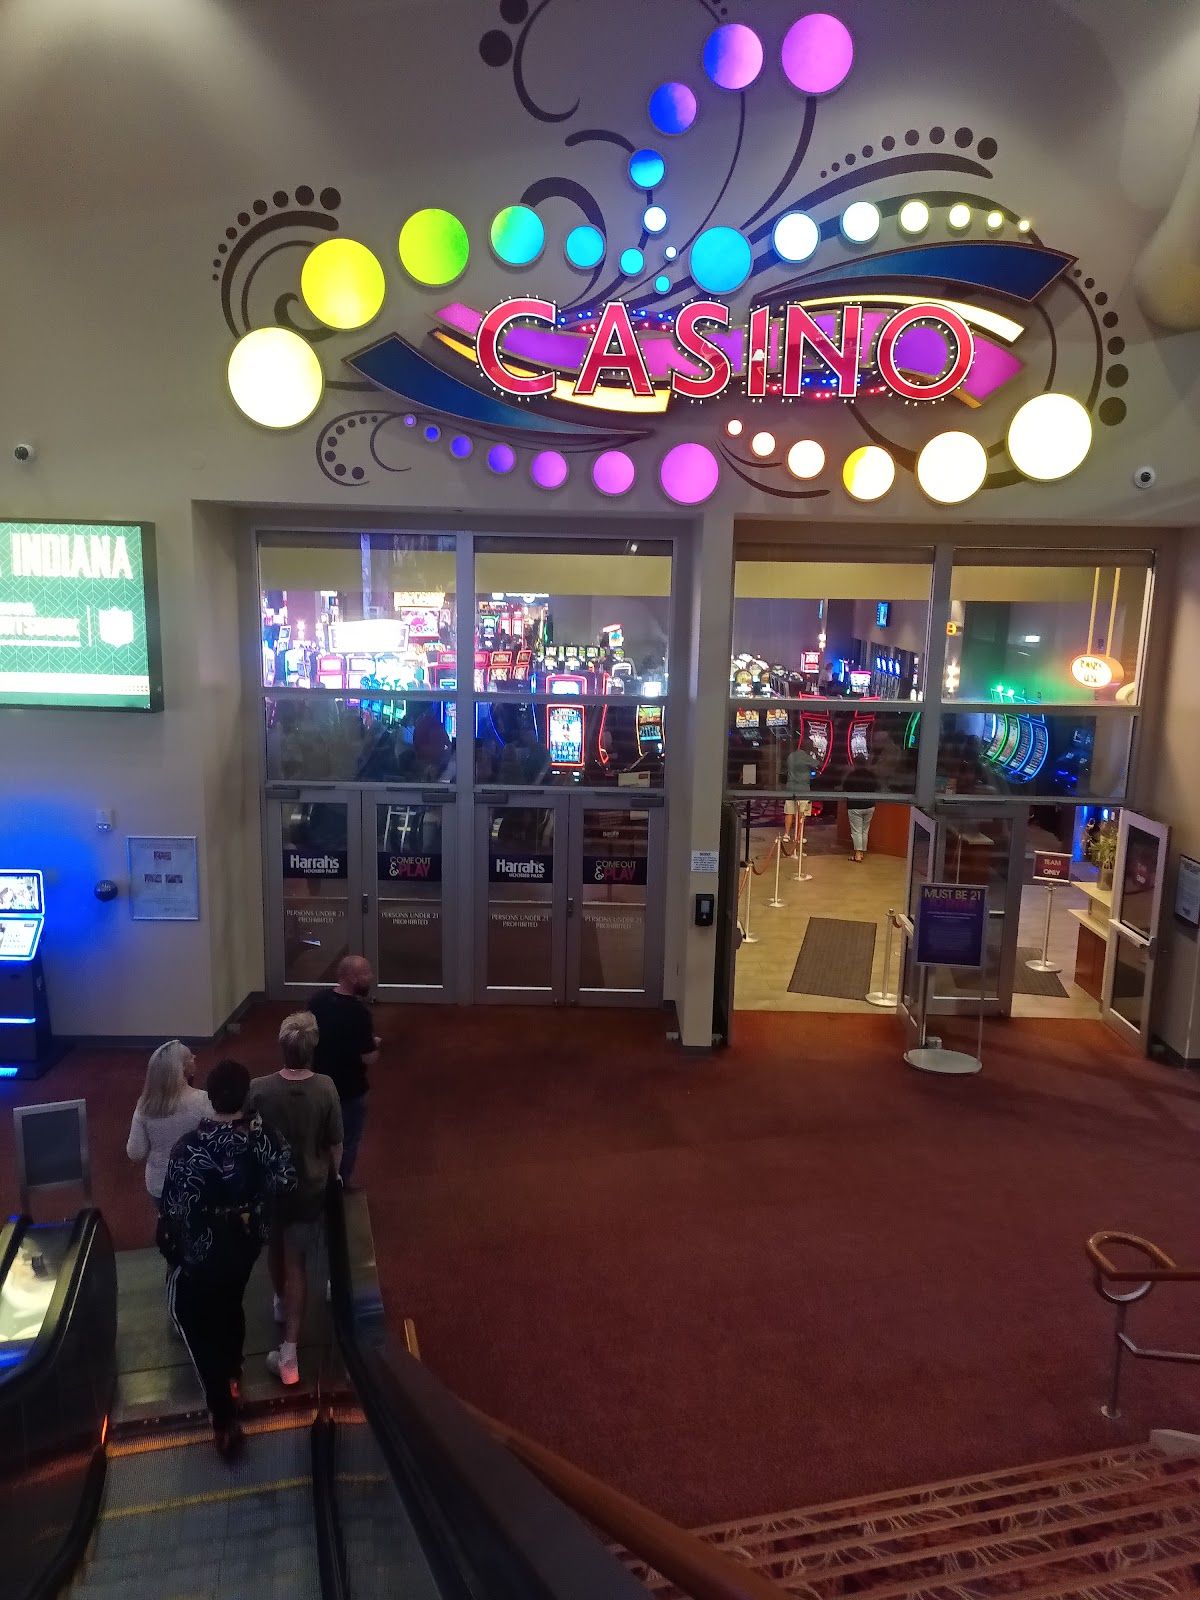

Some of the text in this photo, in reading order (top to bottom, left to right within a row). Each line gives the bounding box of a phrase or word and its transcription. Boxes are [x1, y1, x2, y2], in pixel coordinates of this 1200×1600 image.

[475, 297, 976, 401] CASINO
[11, 533, 134, 579] INDIANA
[389, 856, 432, 865] COME OUT
[595, 860, 637, 868] COME OUT
[399, 864, 431, 877] PLAY
[604, 867, 635, 880] PLAY
[924, 888, 981, 901] MUST BE 21
